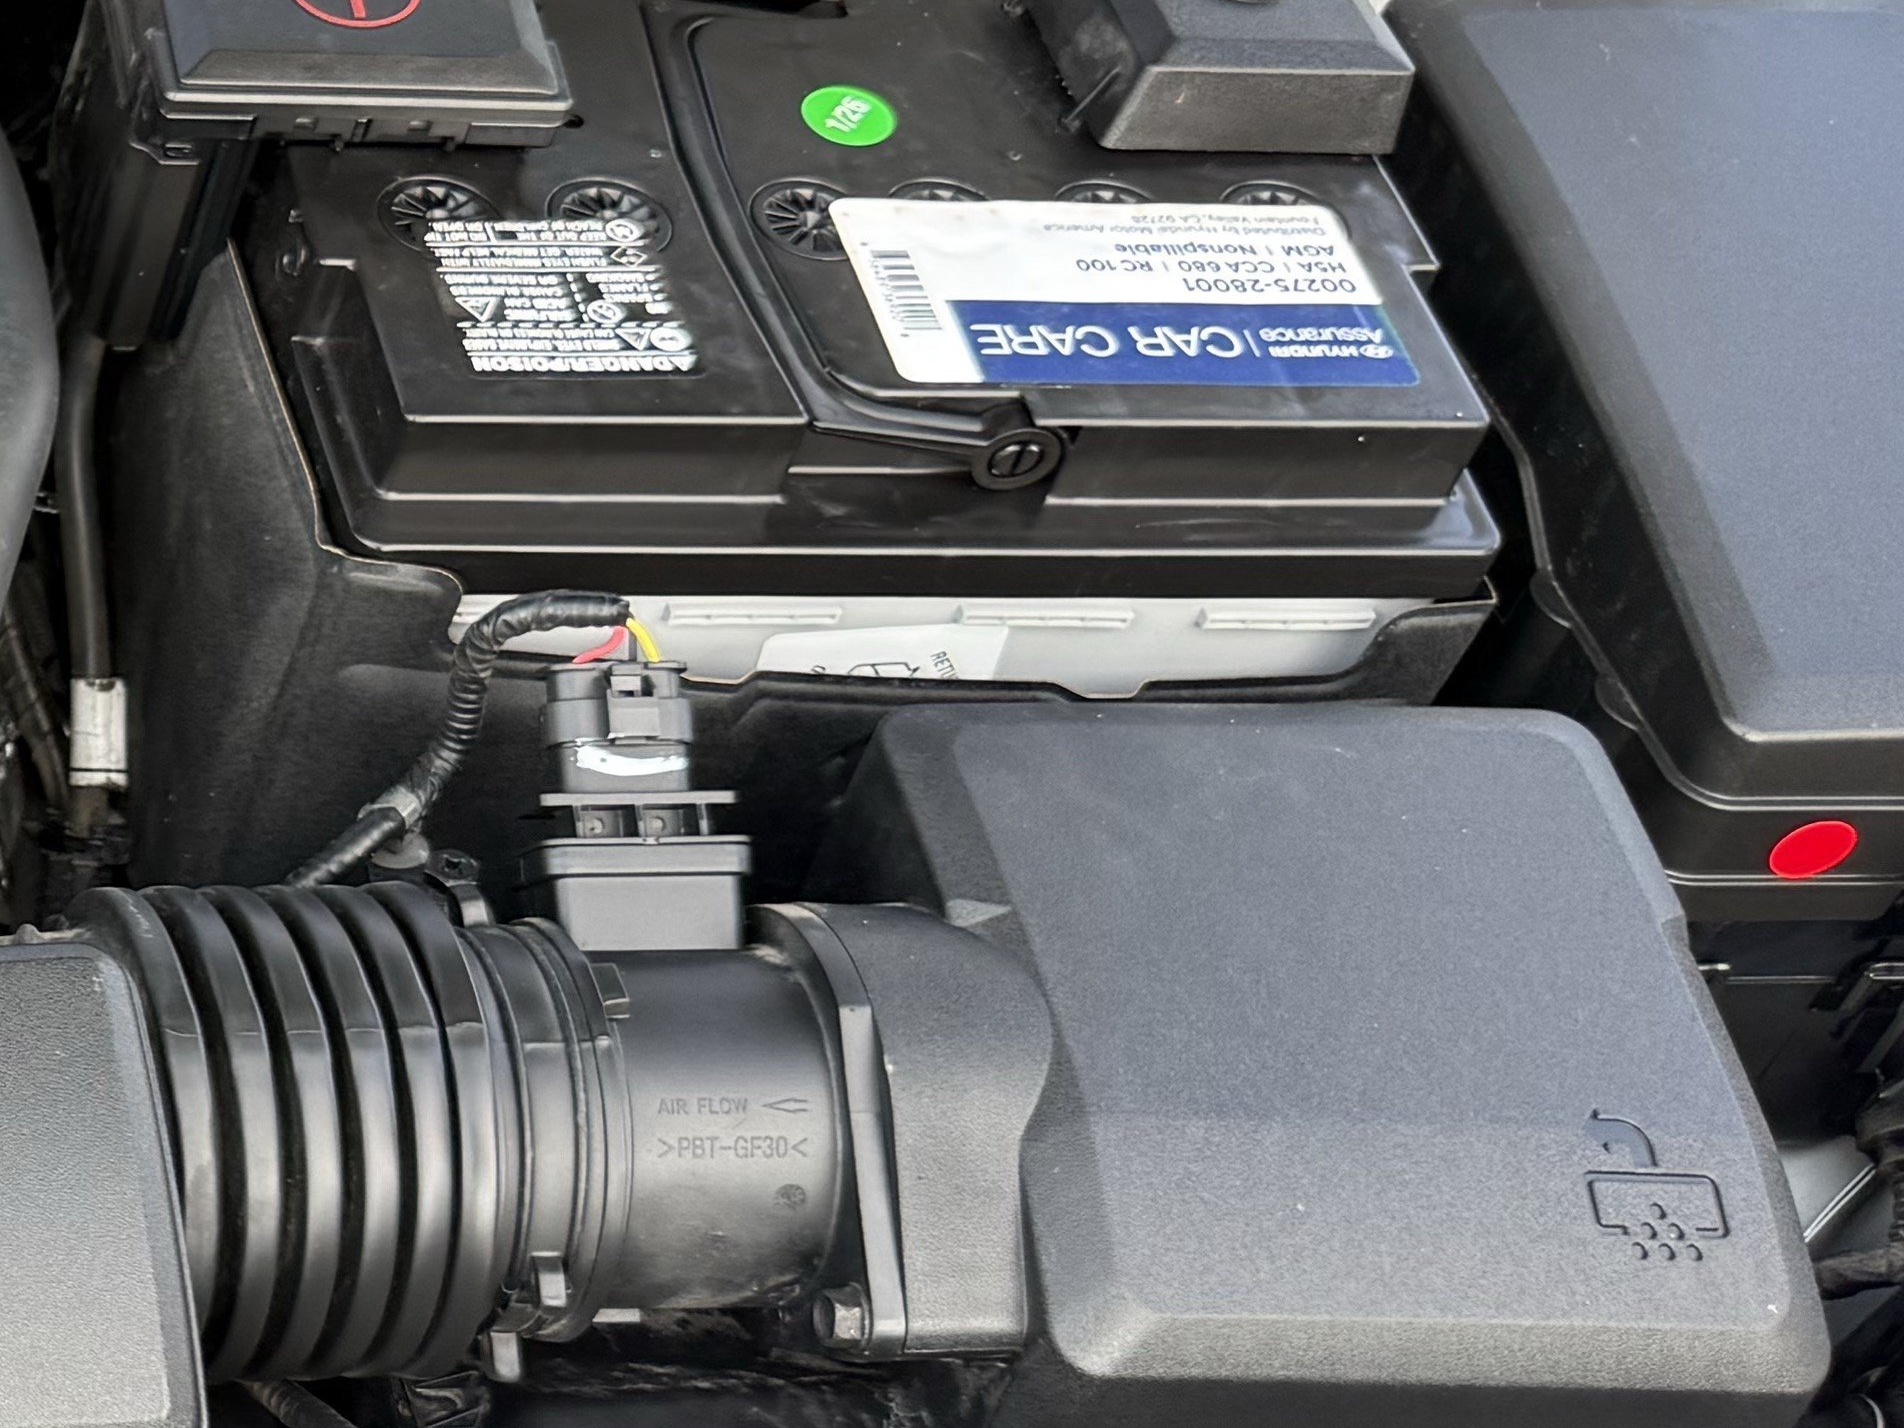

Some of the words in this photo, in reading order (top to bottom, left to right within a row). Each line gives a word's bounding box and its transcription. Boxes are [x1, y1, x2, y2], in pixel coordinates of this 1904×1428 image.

[824, 94, 873, 133] 1/26
[1042, 222, 1106, 234] America
[1106, 223, 1153, 235] Motor
[1156, 222, 1220, 236] Hyundai
[1221, 224, 1240, 237] by
[1241, 225, 1327, 237] Distributed
[1113, 241, 1257, 257] Nonspillable
[1281, 244, 1335, 257] AGM
[1120, 258, 1153, 272] RC
[1177, 260, 1219, 273] 680
[1224, 260, 1275, 273] CCA
[1182, 277, 1357, 293] 00275-28001
[970, 323, 1120, 358] CARE
[1126, 325, 1244, 359] CAR
[1258, 326, 1382, 345] Assurance
[1267, 344, 1360, 359] HYUNDAI
[470, 356, 675, 372] DANGER/POISON
[657, 1097, 690, 1115] AIR
[696, 1097, 749, 1115] FLOW
